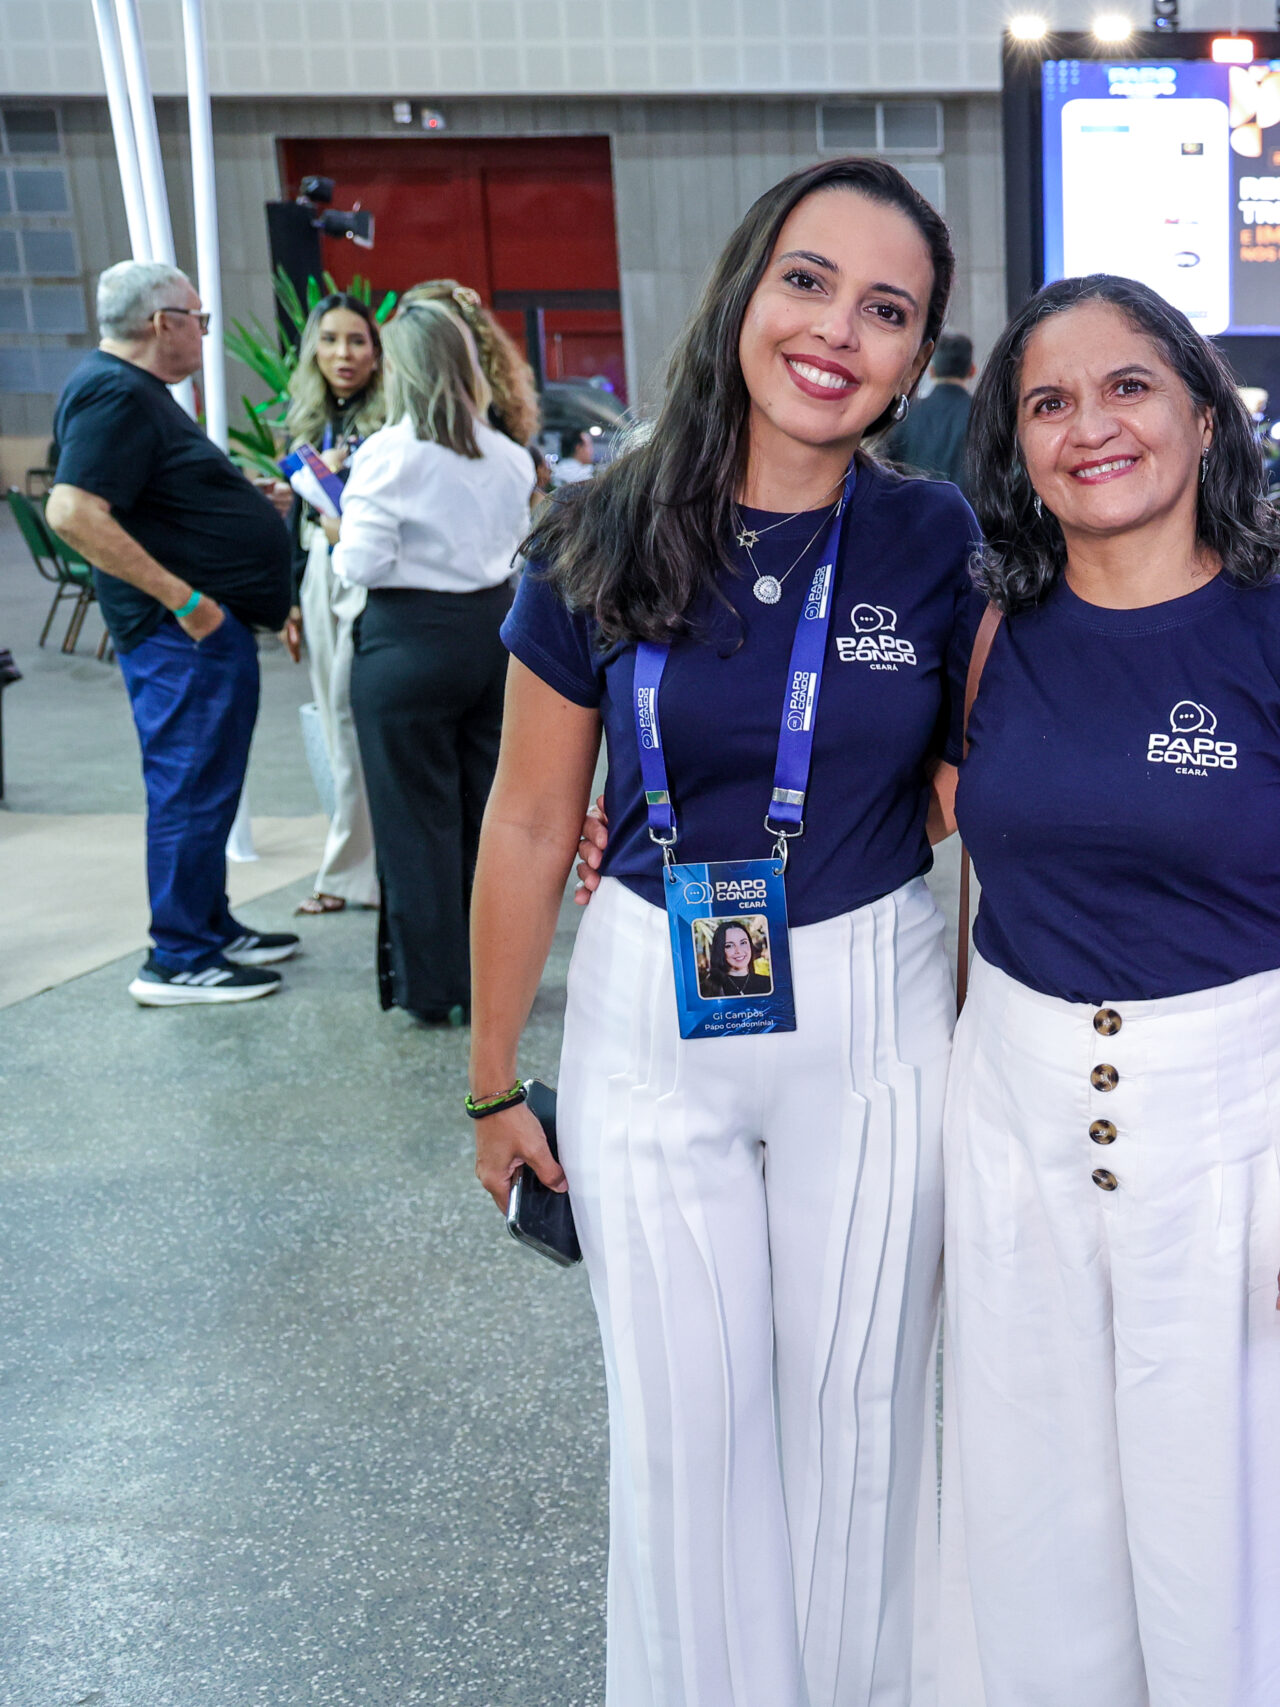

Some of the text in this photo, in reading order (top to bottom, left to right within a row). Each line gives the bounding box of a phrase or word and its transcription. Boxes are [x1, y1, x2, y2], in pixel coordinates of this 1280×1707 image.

[1240, 246, 1277, 262] NOS
[808, 567, 821, 602] PAPO
[815, 565, 826, 600] CONDO
[835, 634, 914, 653] PAPO
[839, 649, 917, 666] CONDO
[869, 663, 898, 671] CEARÁ
[789, 671, 802, 710] PAPO
[798, 671, 809, 710] CONDO
[637, 687, 646, 728] PAPO
[643, 687, 651, 728] CONDO
[1148, 733, 1237, 756] PAPO
[1147, 750, 1237, 769] CONDO
[1175, 767, 1208, 777] CEARÁ
[715, 878, 766, 892] PAPO
[716, 889, 767, 901] CONDO
[738, 898, 767, 909] CEARÁ
[712, 1010, 764, 1020] Gi Campos
[704, 1019, 774, 1031] Papo Condominial
